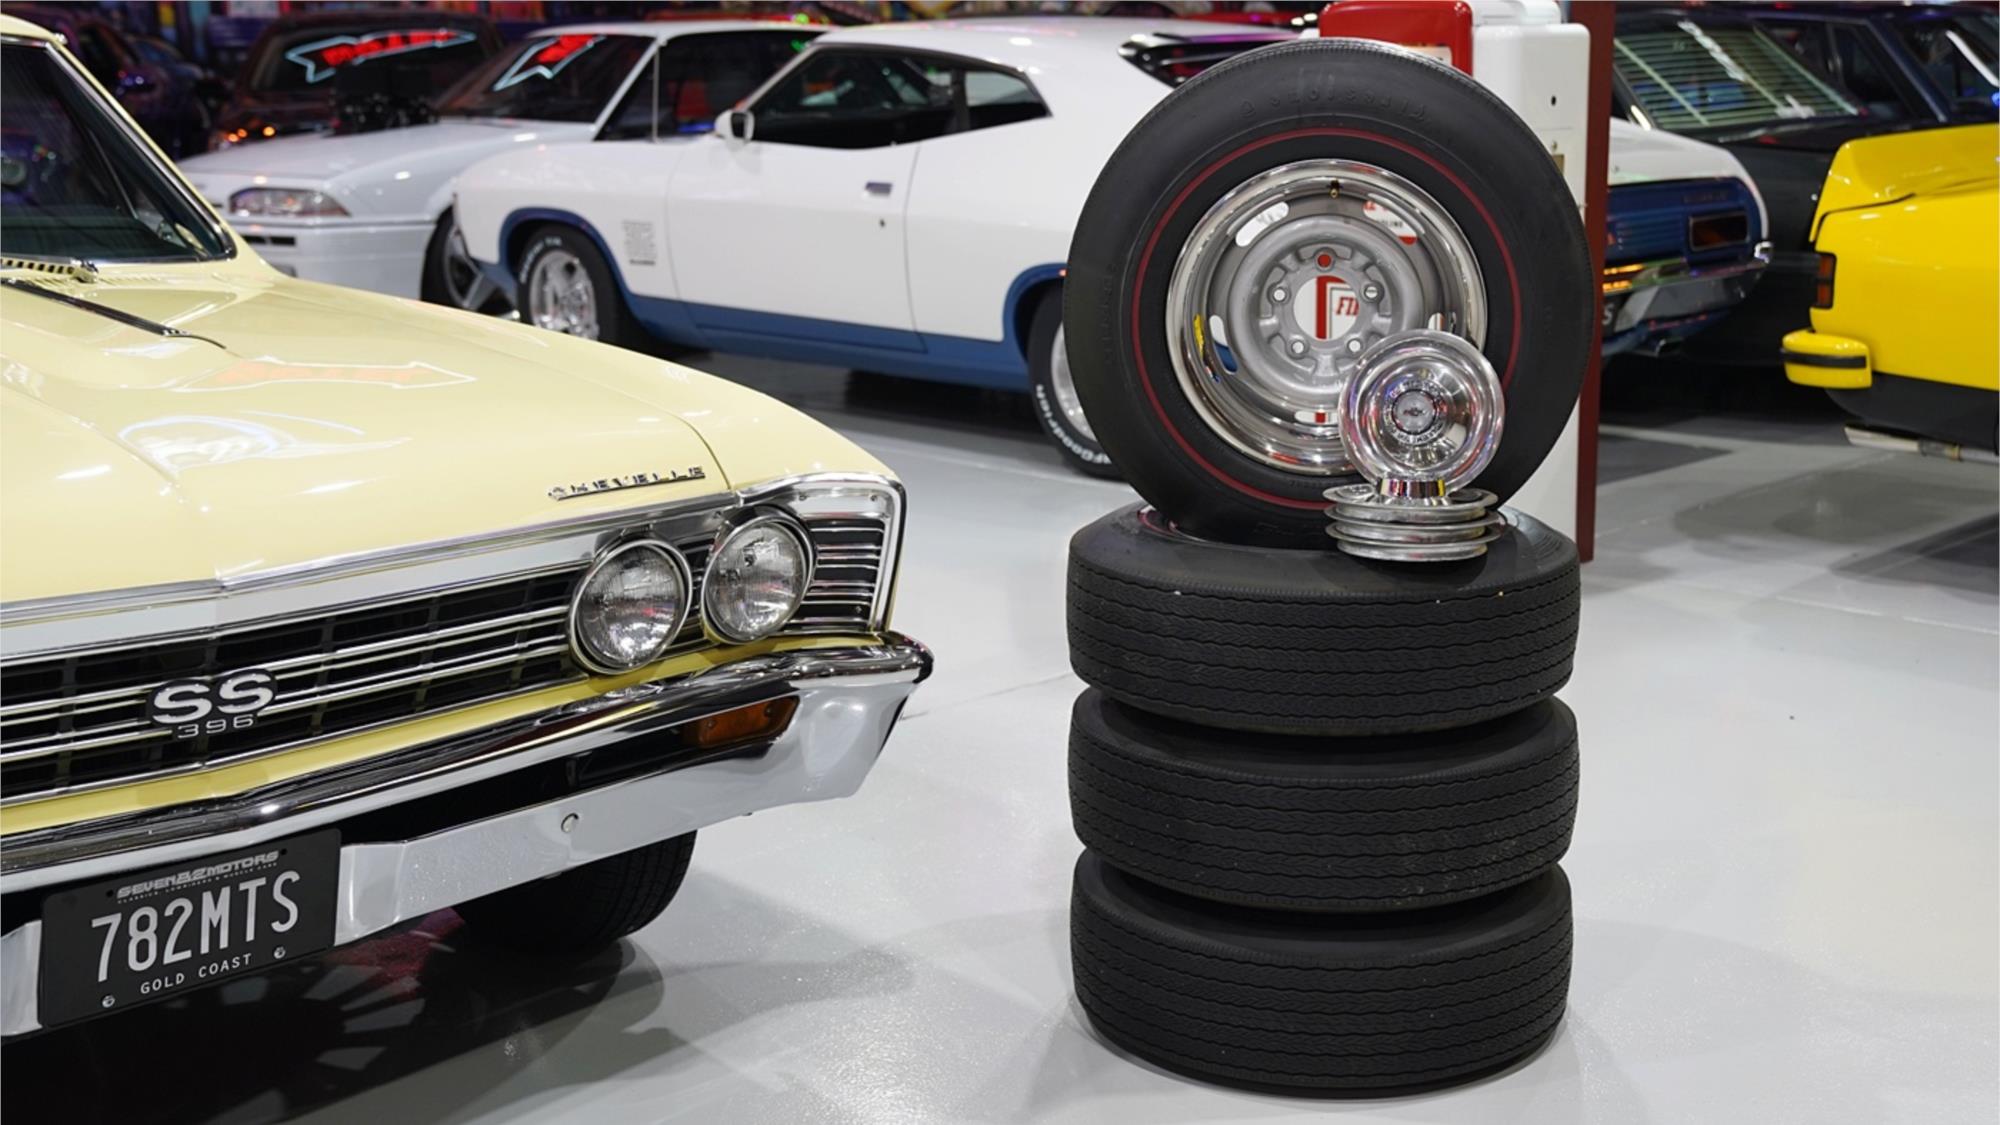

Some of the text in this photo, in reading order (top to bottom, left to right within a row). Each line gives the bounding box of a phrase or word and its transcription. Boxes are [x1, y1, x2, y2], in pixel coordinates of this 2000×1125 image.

[548, 466, 706, 501] CHEVELLE
[152, 673, 273, 724] SS
[178, 714, 253, 738] 396
[91, 870, 300, 982] 782MTS
[140, 953, 252, 994] GOLD COAST
